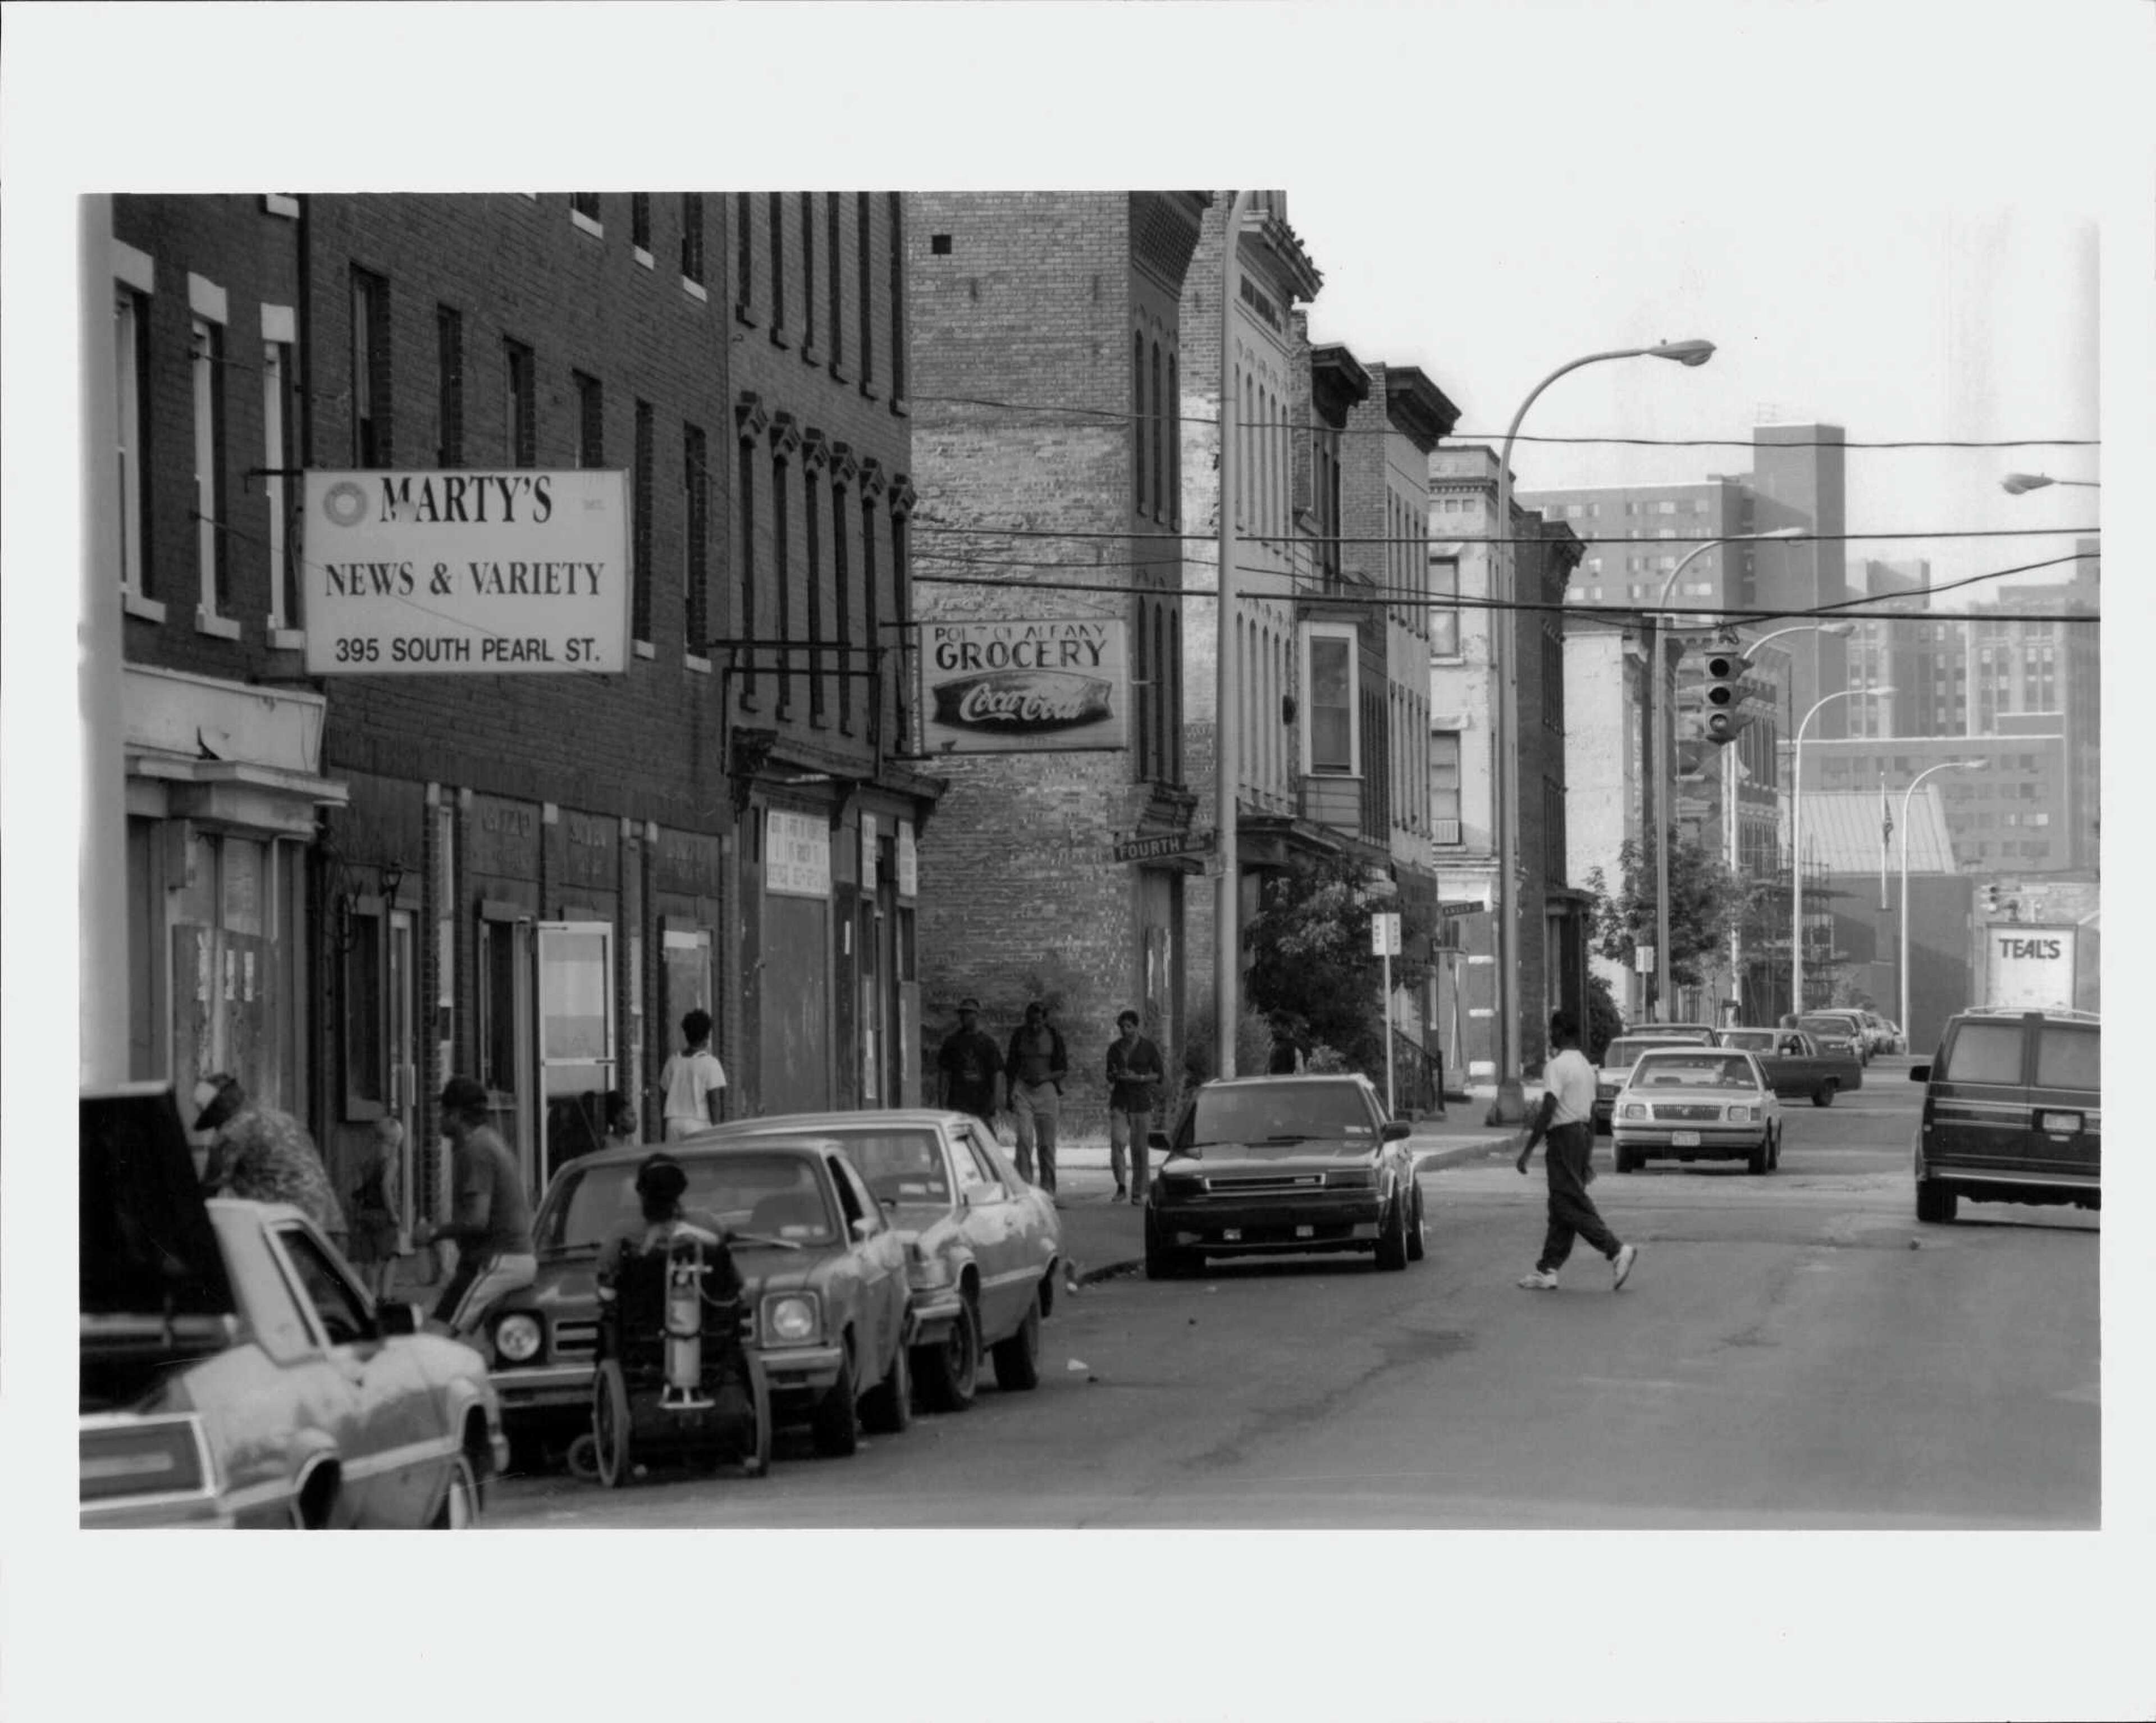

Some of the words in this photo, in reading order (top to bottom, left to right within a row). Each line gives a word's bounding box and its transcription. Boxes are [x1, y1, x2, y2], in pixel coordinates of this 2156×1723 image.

[379, 475, 552, 523] MARTY'S
[325, 562, 414, 596] NEWS
[428, 562, 452, 595] &
[469, 562, 605, 595] VARIETY
[336, 637, 380, 662] 395
[392, 637, 469, 662] SOUTH
[482, 637, 555, 662] PEARL
[565, 637, 600, 662] ST.
[935, 640, 1107, 671] GROCERY
[1120, 837, 1180, 860] FOURTH
[1998, 938, 2061, 959] TEAL'S
